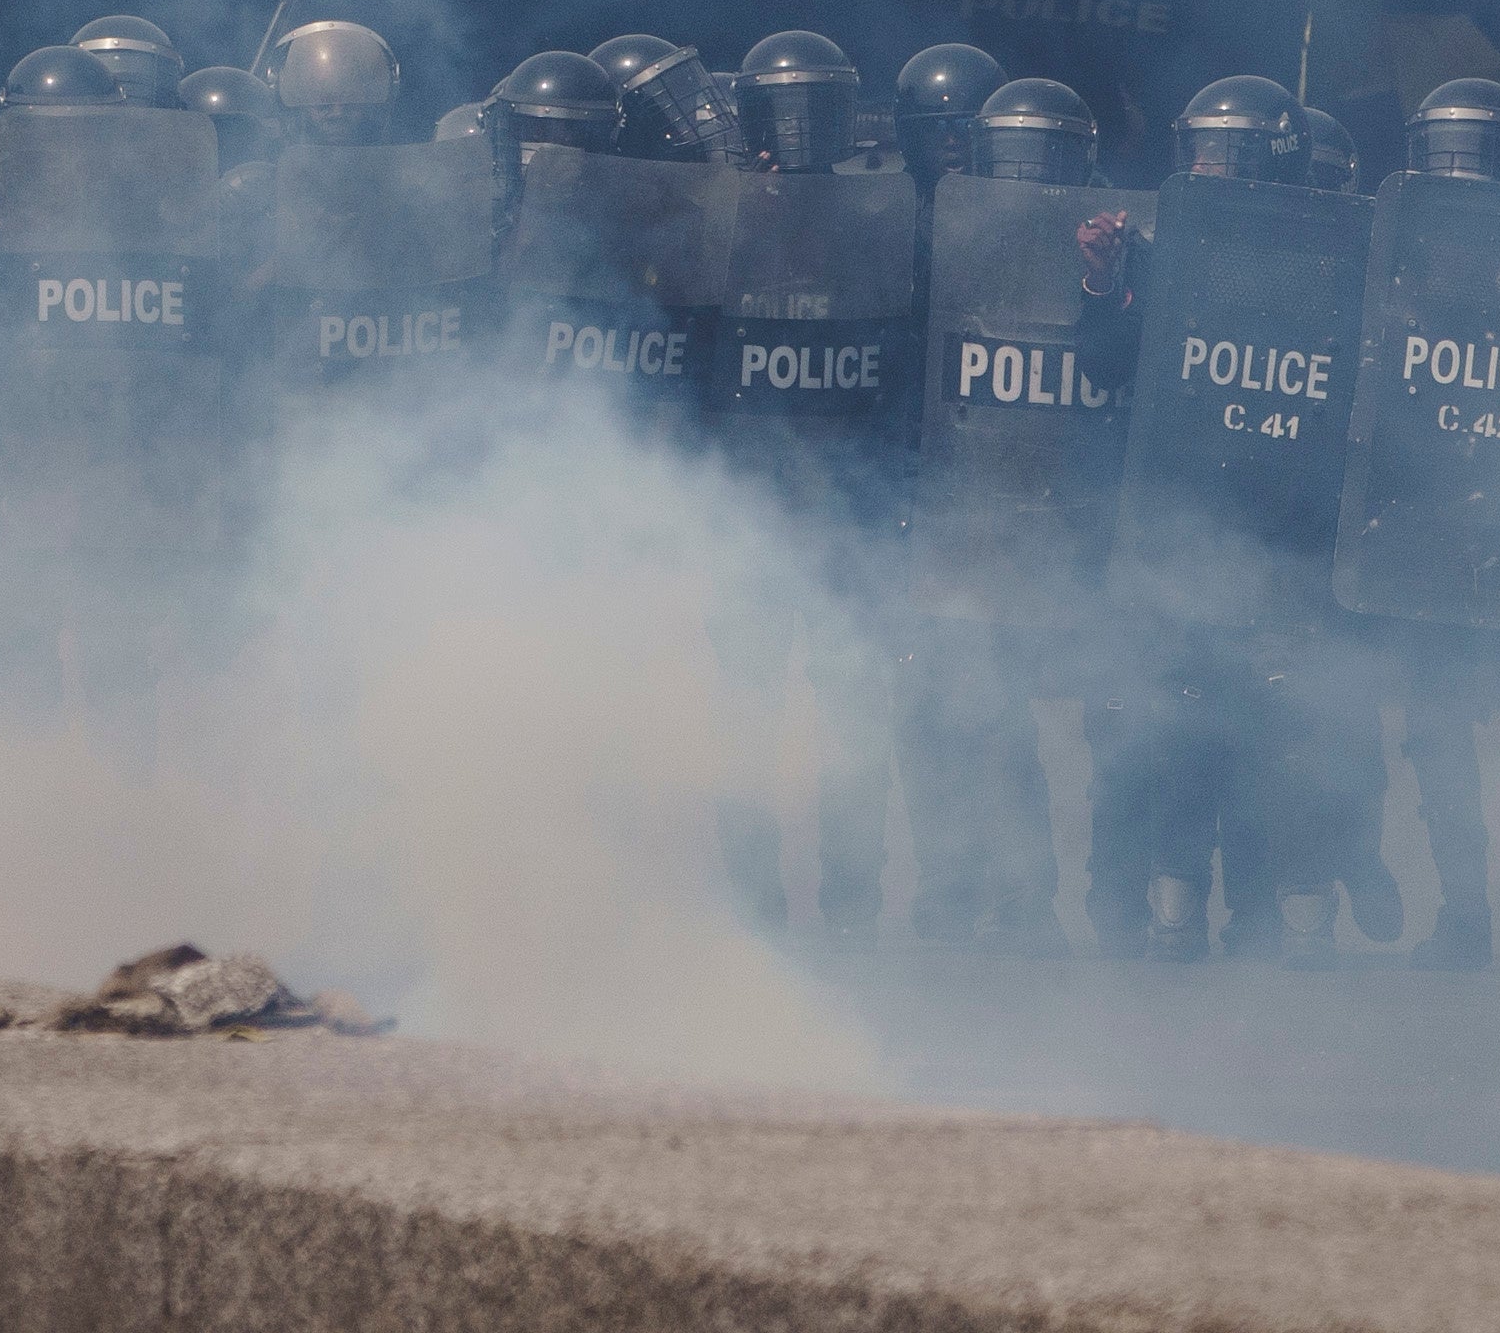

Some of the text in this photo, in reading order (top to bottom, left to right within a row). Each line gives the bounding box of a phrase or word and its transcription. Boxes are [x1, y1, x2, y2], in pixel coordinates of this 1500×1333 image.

[1271, 134, 1300, 156] POLICE
[38, 278, 185, 325] POLICE
[320, 308, 462, 358] POLICE
[546, 321, 688, 375] POLICE
[741, 344, 880, 390] POLICE
[959, 342, 1130, 409] POLIC
[1181, 336, 1332, 400] POLICE
